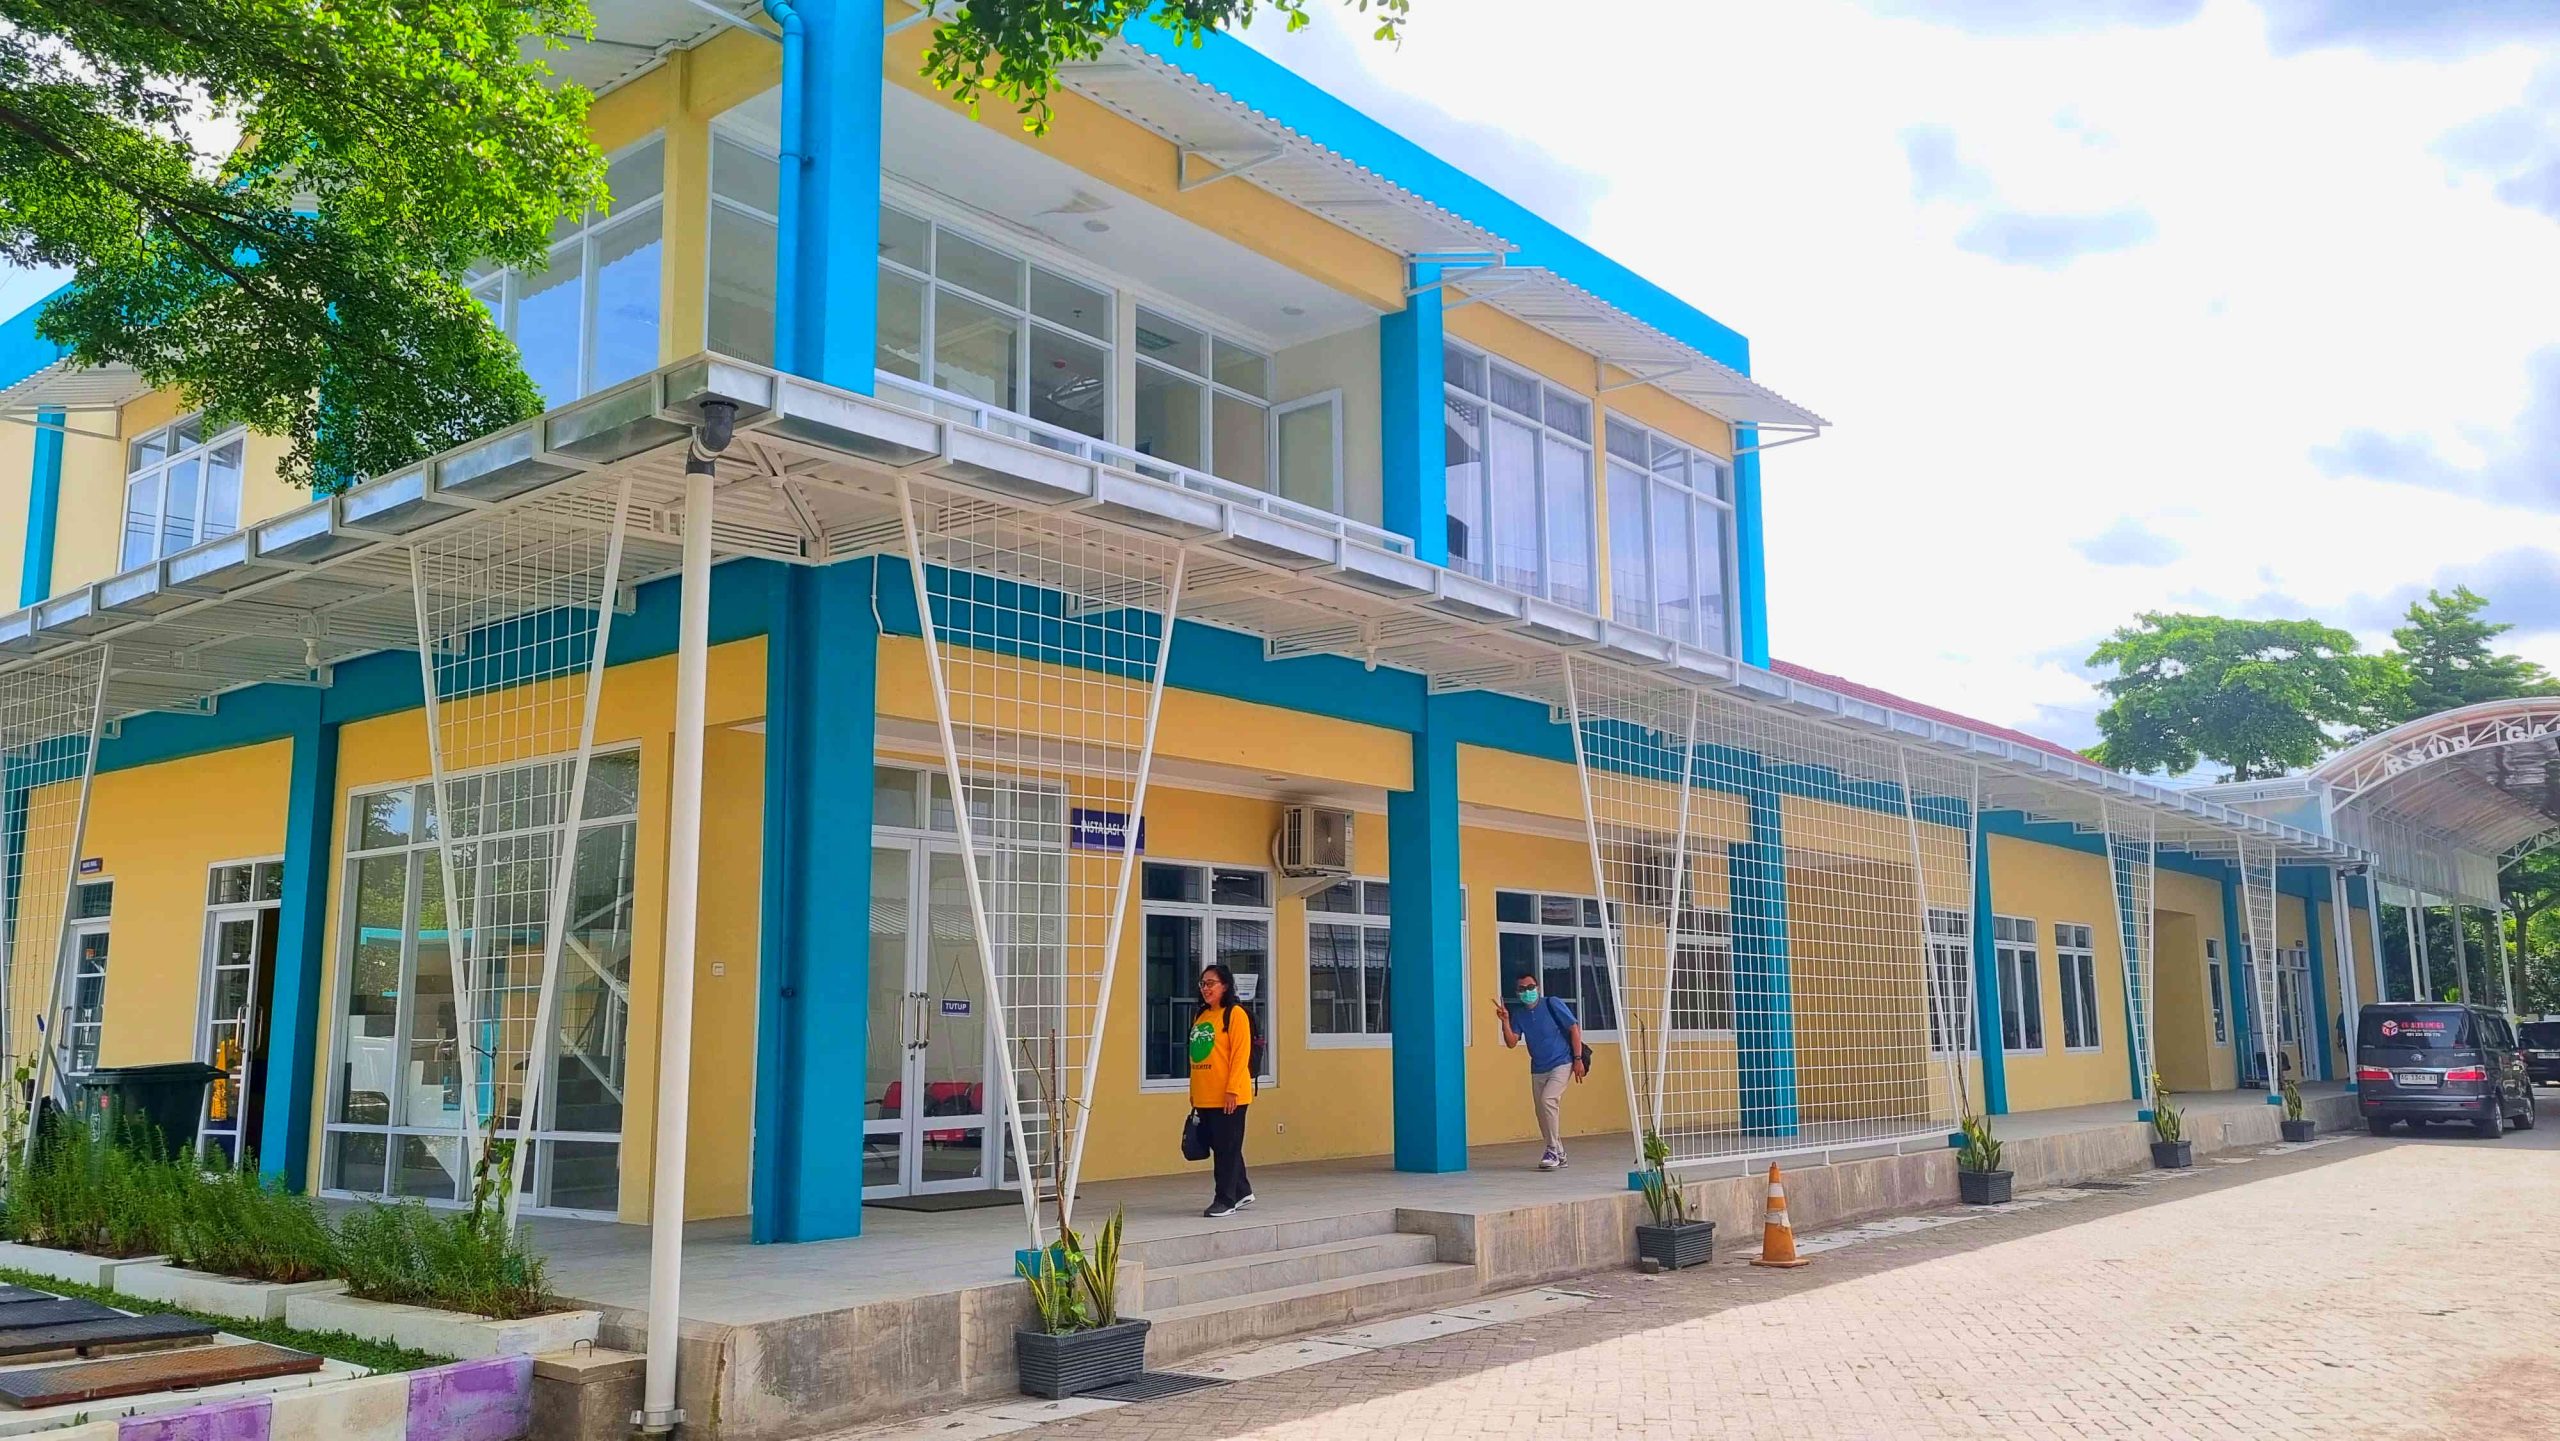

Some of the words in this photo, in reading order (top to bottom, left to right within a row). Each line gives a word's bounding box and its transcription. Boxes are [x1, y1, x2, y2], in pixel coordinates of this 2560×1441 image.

[2387, 736, 2470, 775] RSUD
[2506, 724, 2560, 742] GA
[1081, 820, 1120, 836] INSTALASI
[945, 1002, 967, 1010] TUTUP
